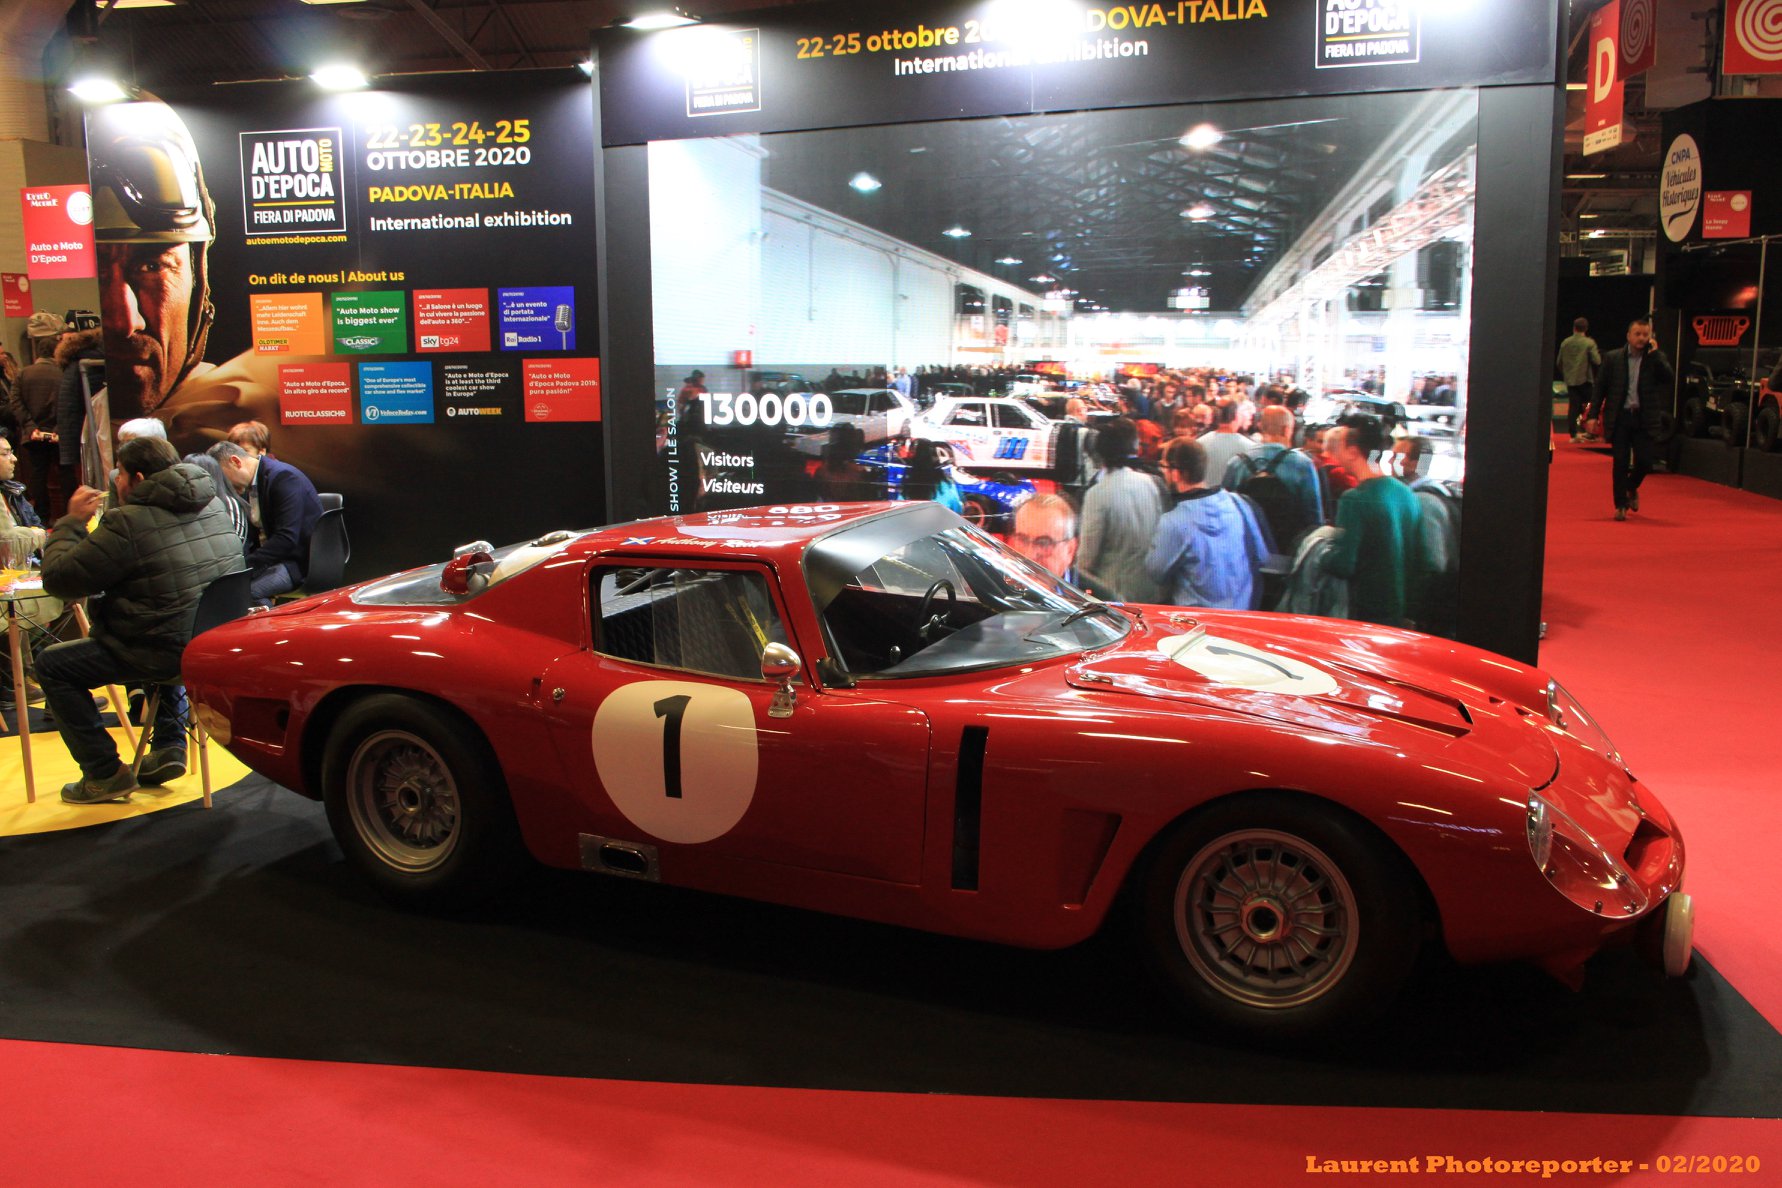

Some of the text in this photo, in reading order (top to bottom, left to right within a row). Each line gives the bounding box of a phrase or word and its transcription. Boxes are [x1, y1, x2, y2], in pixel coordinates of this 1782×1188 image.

[1084, 0, 1268, 33] DOVA-ITALIA
[796, 33, 860, 59] 22-25
[866, 24, 959, 52] ottobre
[1326, 44, 1354, 58] FIERA
[1355, 43, 1366, 56] DI
[1594, 37, 1616, 103] D
[366, 120, 531, 149] 22-23-24-25
[252, 140, 320, 174] AUTO
[319, 138, 334, 172] MOTO
[366, 146, 531, 171] OTTOBRE 2020
[1671, 148, 1690, 165] CNPA
[252, 173, 334, 200] D'EPOCA
[368, 182, 514, 203] PADOVA-ITALIA
[254, 208, 335, 224] FIERA DI PADOVA
[370, 210, 572, 231] International exhibition
[60, 242, 83, 250] Moto
[246, 235, 347, 246] autoemotodepoca.com
[32, 255, 67, 264] D'Epoca
[249, 274, 267, 285] On
[270, 273, 287, 284] dit
[290, 273, 305, 284] de
[308, 273, 338, 283] nous
[348, 271, 387, 282] About
[390, 272, 404, 281] us
[345, 317, 377, 326] biggest
[440, 337, 459, 346] tg24
[666, 387, 676, 435] SALON
[698, 392, 833, 426] 130000
[668, 439, 677, 456] LE
[700, 452, 754, 467] Visitors
[669, 467, 679, 512] SHOW
[702, 478, 764, 494] Visiteurs
[654, 694, 692, 799] 1
